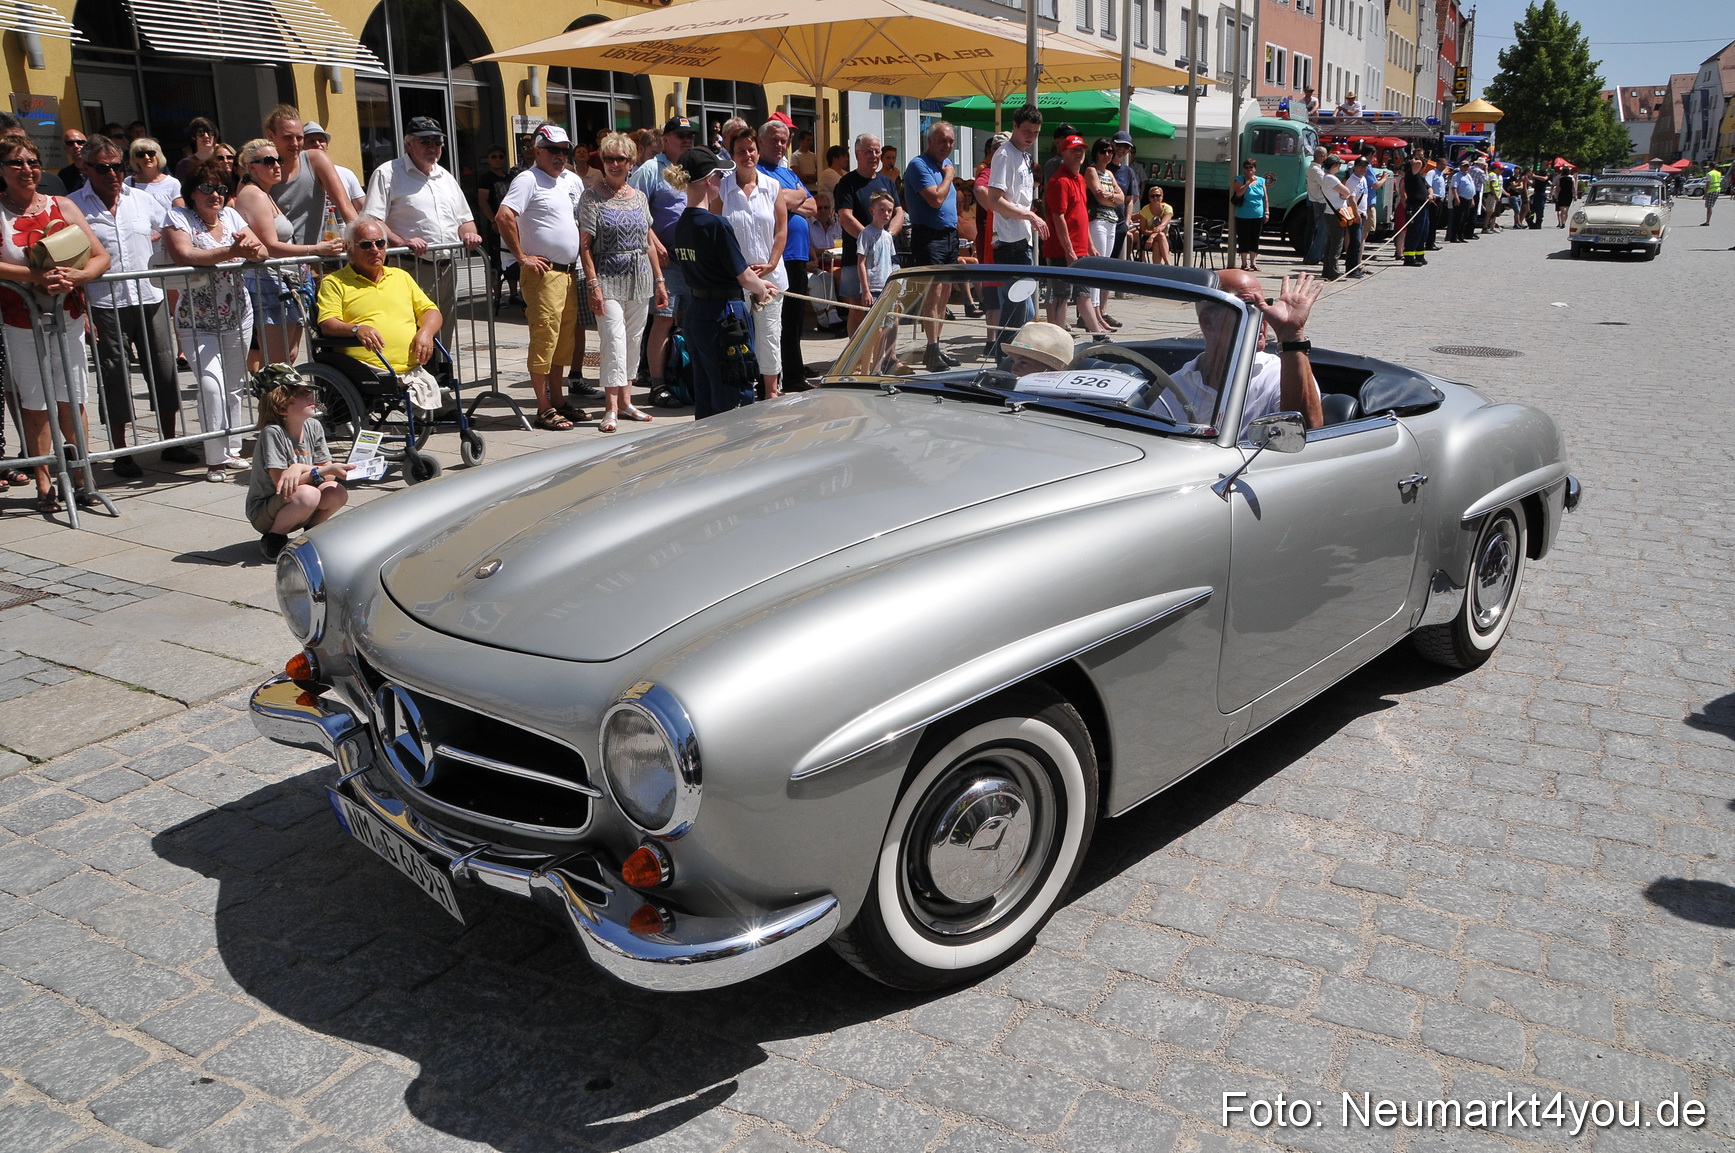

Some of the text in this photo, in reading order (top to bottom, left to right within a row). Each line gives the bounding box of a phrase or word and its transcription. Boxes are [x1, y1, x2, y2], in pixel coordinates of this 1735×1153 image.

[609, 12, 790, 38] BELACCANTO
[1455, 67, 1468, 109] HOT
[17, 108, 57, 119] hailer
[831, 112, 839, 123] 24
[1143, 160, 1187, 183] RÄU
[674, 248, 696, 262] THW
[1070, 375, 1111, 389] 526
[344, 802, 377, 849] NM
[380, 828, 400, 867] G
